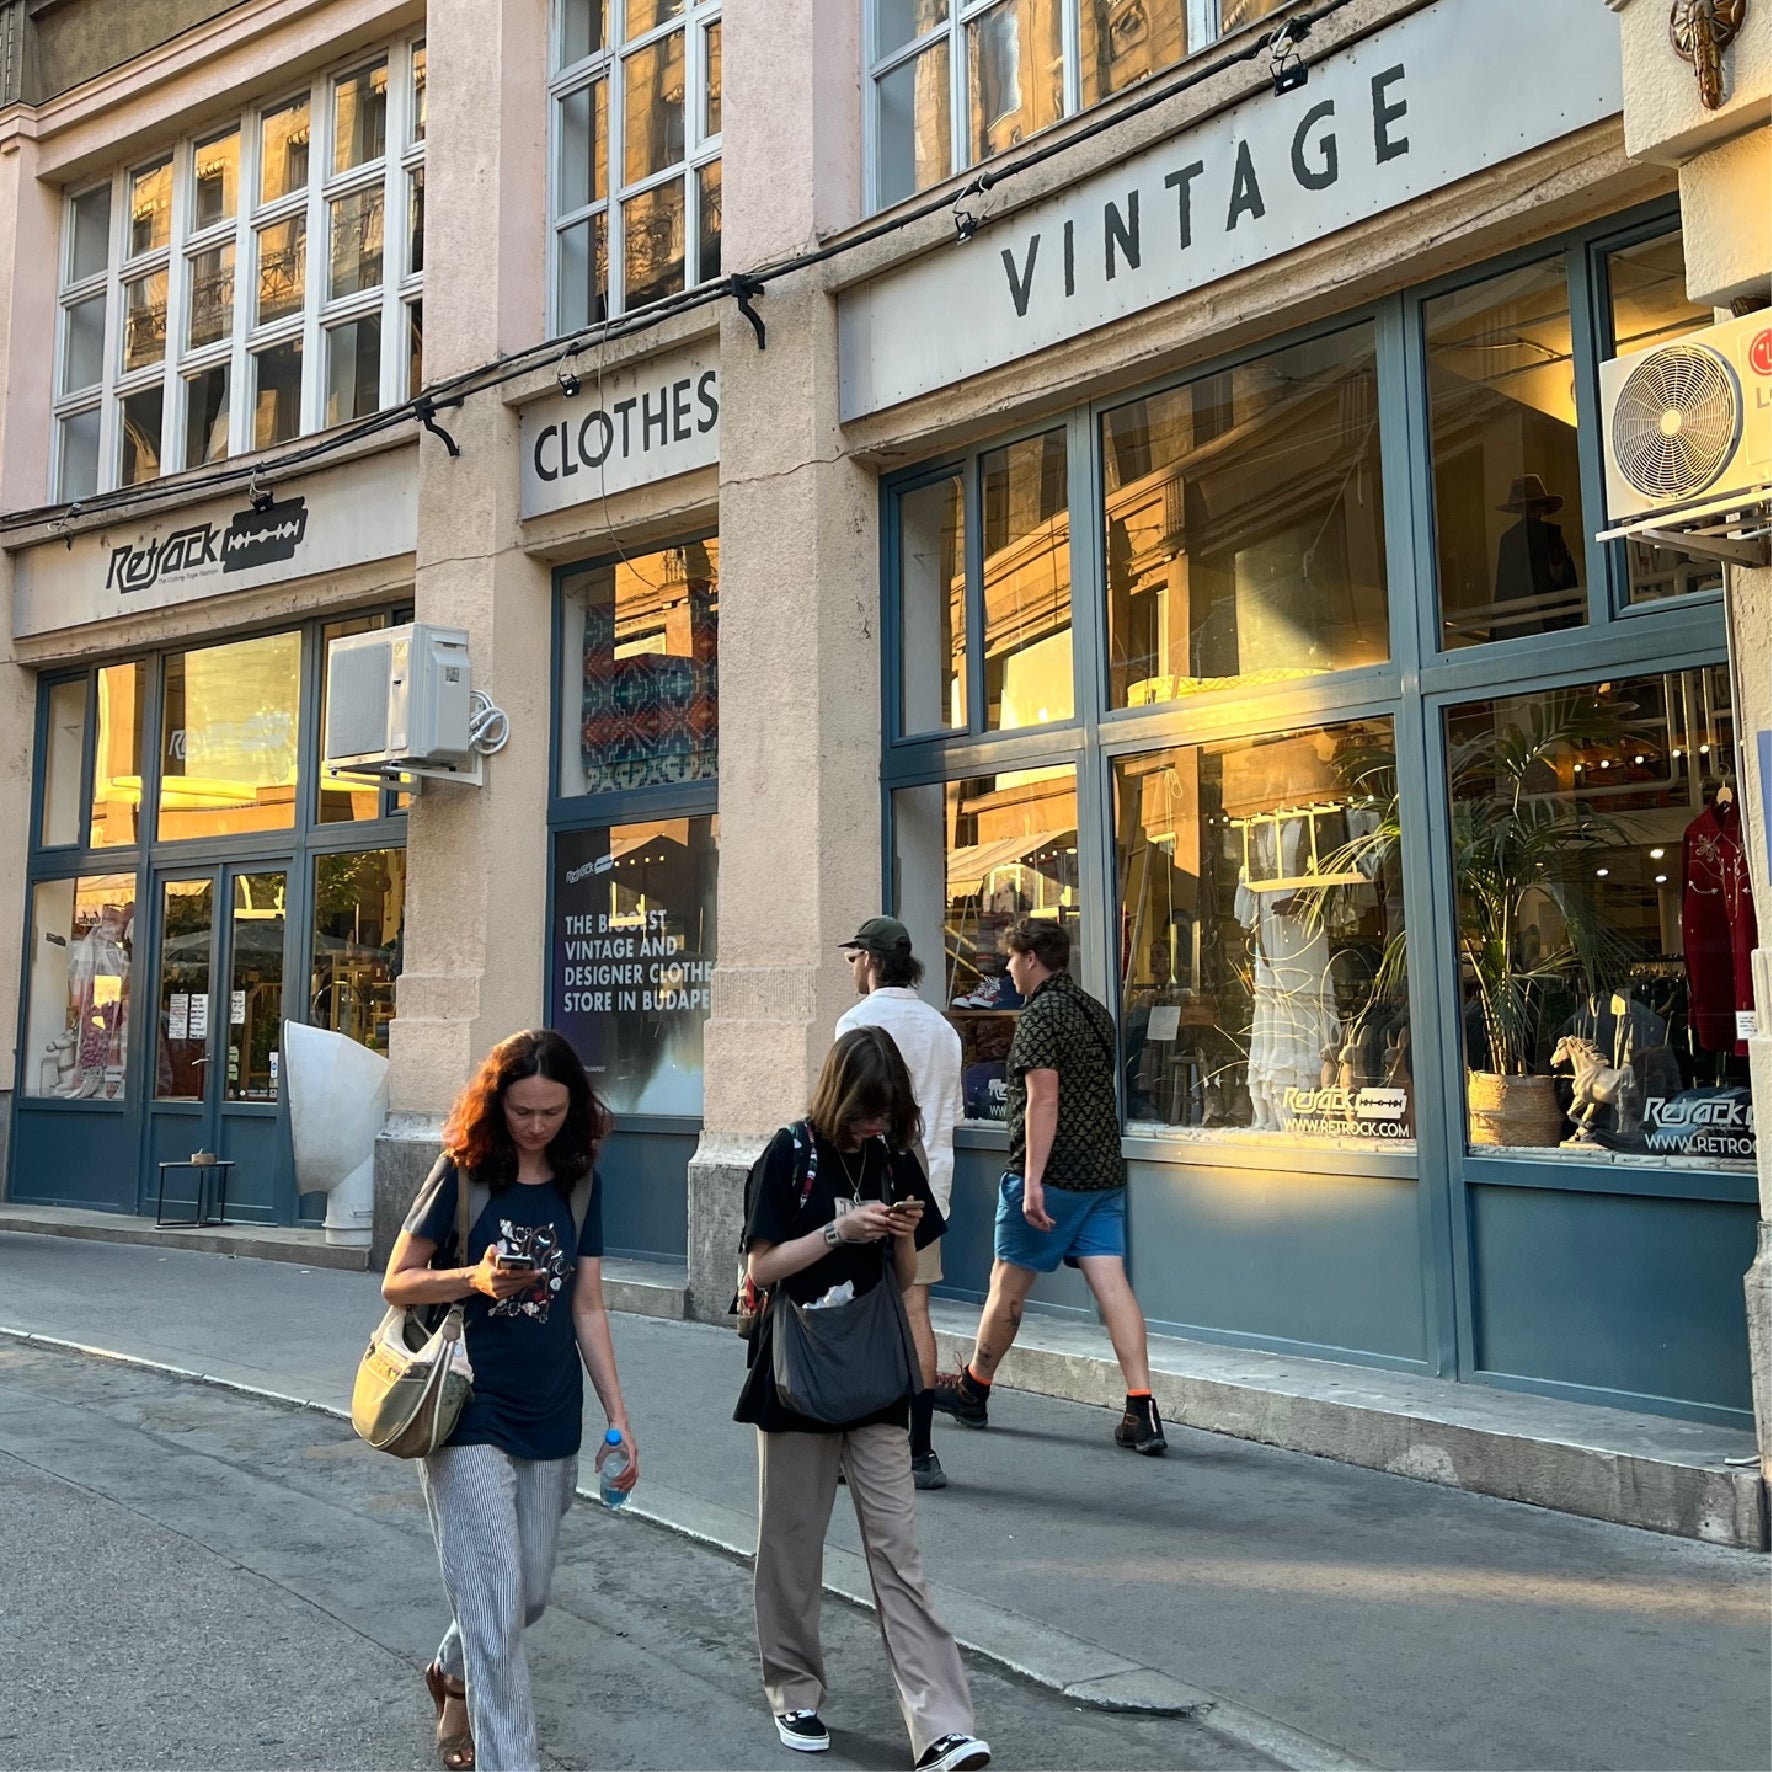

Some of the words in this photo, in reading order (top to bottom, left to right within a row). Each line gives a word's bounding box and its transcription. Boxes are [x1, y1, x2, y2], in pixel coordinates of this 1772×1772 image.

[1000, 63, 1410, 318] VINTAGE
[1756, 387, 1772, 409] L
[534, 370, 719, 481] CLOTHES
[565, 914, 593, 935] THE
[565, 938, 635, 961] VINTAGE
[640, 935, 678, 958] AND
[564, 964, 643, 986] DESIGNER
[564, 991, 612, 1012] STORE
[618, 991, 636, 1011] IN
[1283, 1116, 1410, 1138] WWW.RETROCK.COM
